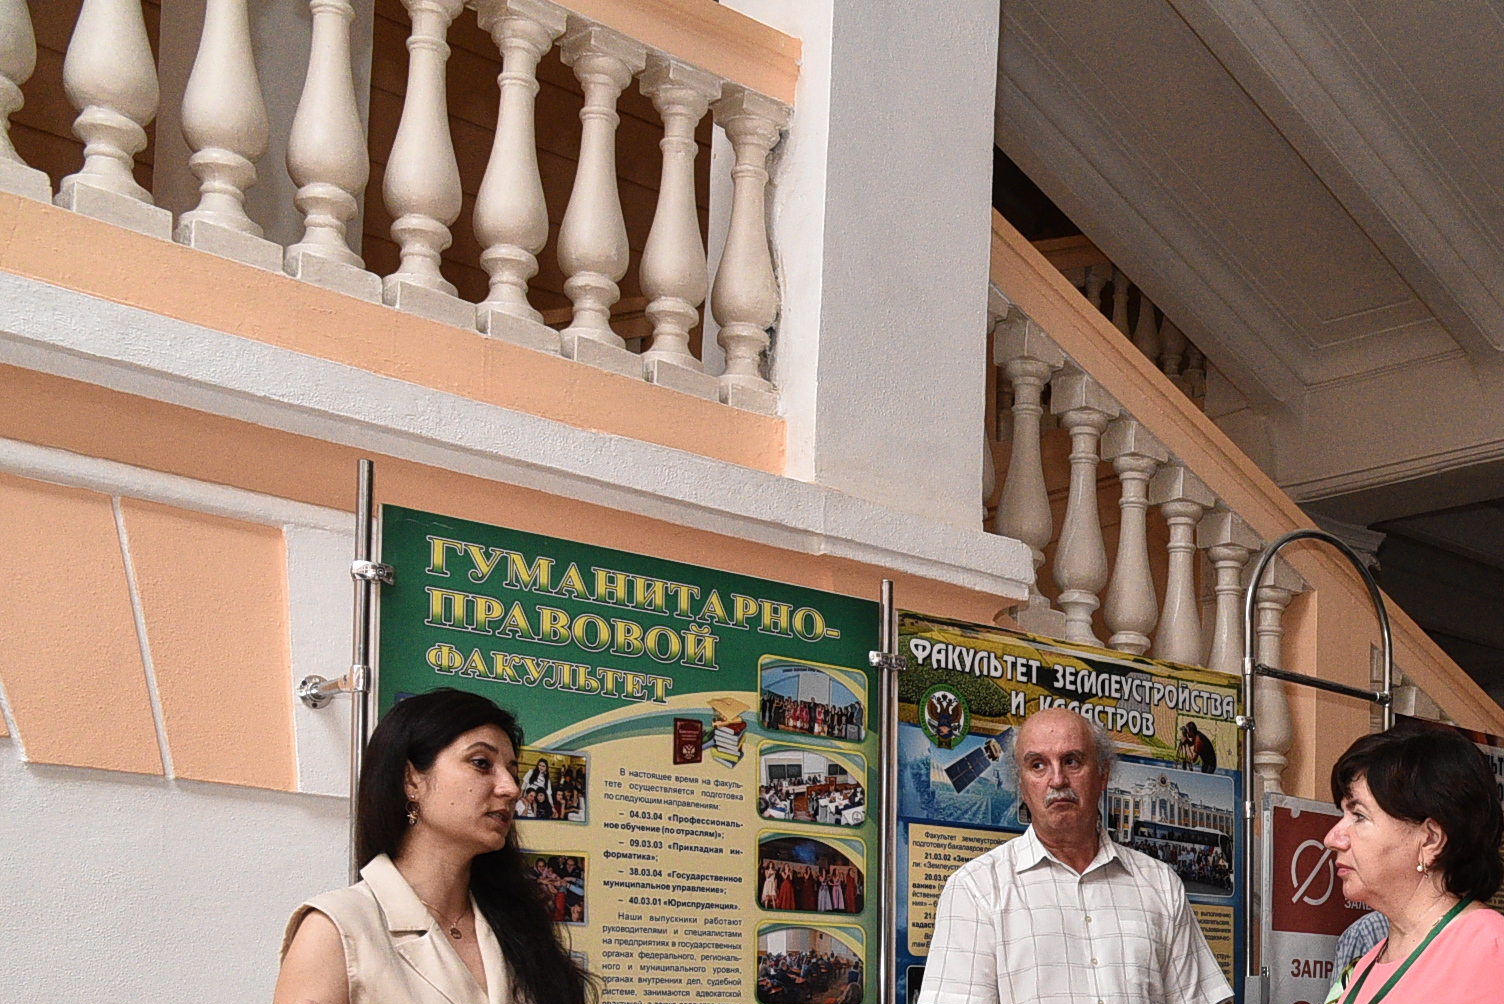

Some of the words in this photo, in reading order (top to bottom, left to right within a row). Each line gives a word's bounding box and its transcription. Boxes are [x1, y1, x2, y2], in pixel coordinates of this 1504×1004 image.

[426, 535, 841, 643] ГУМАНИТАРНО-
[425, 586, 719, 670] ПРАВОВОЙ
[425, 643, 673, 704] ФАКУЛЬТЕТ
[909, 638, 1041, 685] ФАКУЛЬТЕТ
[1053, 664, 1236, 720] ЗЕМЛЕУСТРОЙСТВА
[1010, 690, 1026, 717] И
[629, 770, 672, 781] настоящее
[675, 775, 699, 784] время
[713, 779, 744, 789] факуль-
[604, 780, 622, 788] тете
[629, 782, 695, 795] осуществляется
[701, 790, 744, 801] подготовка
[615, 794, 662, 804] следующим
[663, 799, 721, 811] направлениям:
[629, 810, 663, 820] 04.03.04
[667, 814, 744, 828] «Профессиональ-
[620, 822, 661, 833] обучение
[661, 826, 675, 835] (по
[925, 831, 957, 841] Факультет
[629, 838, 663, 849] 09.03.03
[667, 842, 724, 854] «Прикладная
[629, 867, 663, 877] 38.03.04
[667, 870, 743, 883] «Государственное
[603, 880, 671, 891] муниципальное
[628, 896, 662, 906] 40.03.01
[618, 912, 642, 921] Наши
[649, 915, 698, 924] выпускники
[704, 916, 742, 926] работают
[602, 925, 668, 935] руководителями
[684, 929, 742, 938] специалистами
[614, 939, 669, 948] предприятиях
[602, 950, 634, 958] органах
[640, 964, 706, 973] муниципального
[637, 976, 682, 985] внутренних
[707, 977, 742, 987] судебной
[643, 989, 690, 997] занимаются
[695, 989, 742, 998] адвокатской
